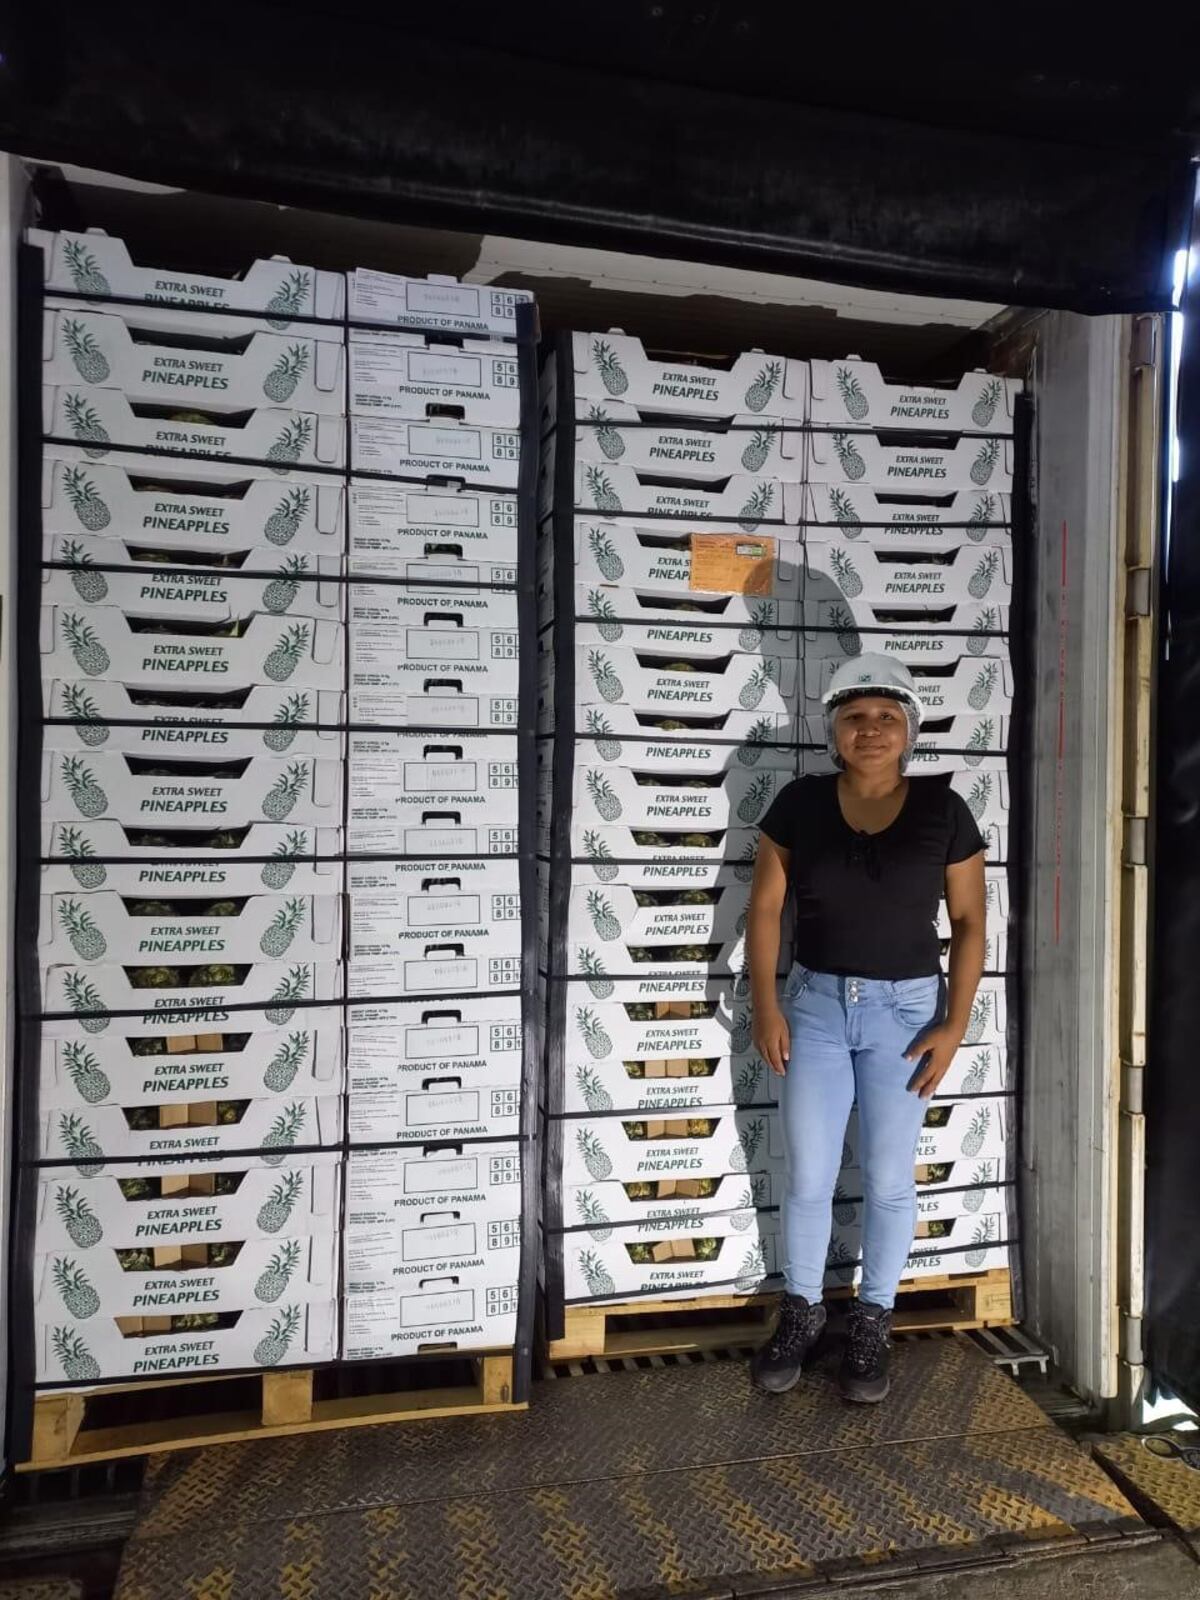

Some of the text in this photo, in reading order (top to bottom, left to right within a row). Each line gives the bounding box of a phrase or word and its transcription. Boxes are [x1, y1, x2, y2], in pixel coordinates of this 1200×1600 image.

[155, 281, 226, 298] EXTRA SWEET
[494, 294, 514, 305] 5 6
[507, 307, 514, 317] 9
[397, 315, 489, 330] PRODUCT OF PANAMA
[154, 358, 225, 373] EXTRA SWEET
[142, 370, 230, 390] PINEAPPLES
[662, 372, 717, 386] EXTRA SWEET
[400, 385, 491, 400] PRODUCT OF PANAMA
[652, 384, 719, 401] PINEAPPLES
[900, 395, 946, 405] EXTRA SWEET
[890, 406, 949, 419] PINEAPPLES
[156, 431, 227, 447] EXTRA SWEET
[658, 436, 712, 448] EXTRA SWEET
[649, 447, 715, 462] PINEAPPLES
[896, 455, 944, 465] EXTRA SWEET
[400, 459, 490, 472] PRODUCT OF PANAMA
[887, 466, 947, 478] PINEAPPLES
[656, 496, 710, 508] EXTRA SWEET
[154, 503, 225, 517] EXTRA SWEET
[892, 513, 940, 522] EXTRA SWEET
[143, 516, 230, 534] PINEAPPLES
[398, 528, 488, 540] PRODUCT OF PANAMA
[658, 557, 682, 566] EXTRA
[188, 576, 222, 586] SWEET
[894, 572, 942, 580] EXTRA SWEET
[885, 583, 945, 594] PINEAPPLES
[140, 587, 228, 603] PINEAPPLES
[398, 597, 488, 608] PRODUCT OF PANAMA
[647, 629, 713, 643] PINEAPPLES
[153, 645, 224, 656] EXTRA SWEET
[884, 640, 943, 650] PINEAPPLES
[142, 658, 230, 673] PINEAPPLES
[398, 664, 488, 673] PRODUCT OF PANAMA
[656, 678, 710, 688] EXTRA SWEET
[917, 685, 941, 693] SWEET
[647, 689, 713, 702] PINEAPPLES
[142, 730, 229, 744] PINEAPPLES
[646, 747, 712, 759] PINEAPPLES
[493, 765, 510, 774] 5 6
[504, 777, 511, 787] 9
[152, 786, 222, 797] EXTRA SWEET
[395, 796, 485, 804] PRODUCT OF PANAMA
[655, 794, 708, 803] EXTRA SWEET
[140, 800, 228, 813] PINEAPPLES
[646, 806, 711, 817] PINEAPPLES
[395, 863, 485, 872] PRODUCT OF PANAMA
[643, 866, 708, 877] PINEAPPLES
[139, 870, 227, 883] PINEAPPLES
[654, 913, 705, 922] EXTRA SWEET
[150, 926, 220, 936] EXTRA SWEET
[399, 932, 439, 940] PRODUCT
[454, 930, 489, 938] PANAMA
[644, 925, 710, 936] PINEAPPLES
[139, 940, 226, 952] PINEAPPLES
[639, 981, 705, 993] PINEAPPLES
[154, 996, 226, 1008] EXTRA SWEET
[143, 1011, 230, 1024] PINEAPPLES
[494, 1028, 513, 1037] 5 6
[646, 1028, 699, 1038] EXTRA SWEET
[506, 1039, 513, 1049] 9
[637, 1040, 702, 1052] PINEAPPLES
[154, 1063, 225, 1076] EXTRA SWEET
[398, 1063, 436, 1071] PRODUCT
[452, 1060, 487, 1069] PANAMA
[143, 1077, 230, 1092] PINEAPPLES
[646, 1086, 698, 1095] EXTRA SWEET
[638, 1097, 702, 1109] PINEAPPLES
[396, 1126, 488, 1139] PRODUCT OF PANAMA
[150, 1137, 220, 1150] EXTRA SWEET
[646, 1147, 699, 1157] EXTRA SWEET
[637, 1159, 702, 1172] PINEAPPLES
[395, 1198, 435, 1207] PRODUCT
[451, 1194, 486, 1203] PANAMA
[147, 1206, 217, 1220] EXTRA SWEET
[647, 1210, 672, 1218] EXTRA
[135, 1219, 223, 1236] PINEAPPLES
[638, 1219, 704, 1232] PINEAPPLES
[393, 1259, 484, 1275] PRODUCT OF PANAMA
[650, 1270, 704, 1280] EXTRA SWEET
[144, 1278, 216, 1290] EXTRA SWEET
[132, 1290, 220, 1307] PINEAPPLES
[391, 1325, 483, 1340] PRODUCT OF PANAMA
[144, 1341, 215, 1356] EXTRA SWEET
[133, 1354, 220, 1372] PINEAPPLES
